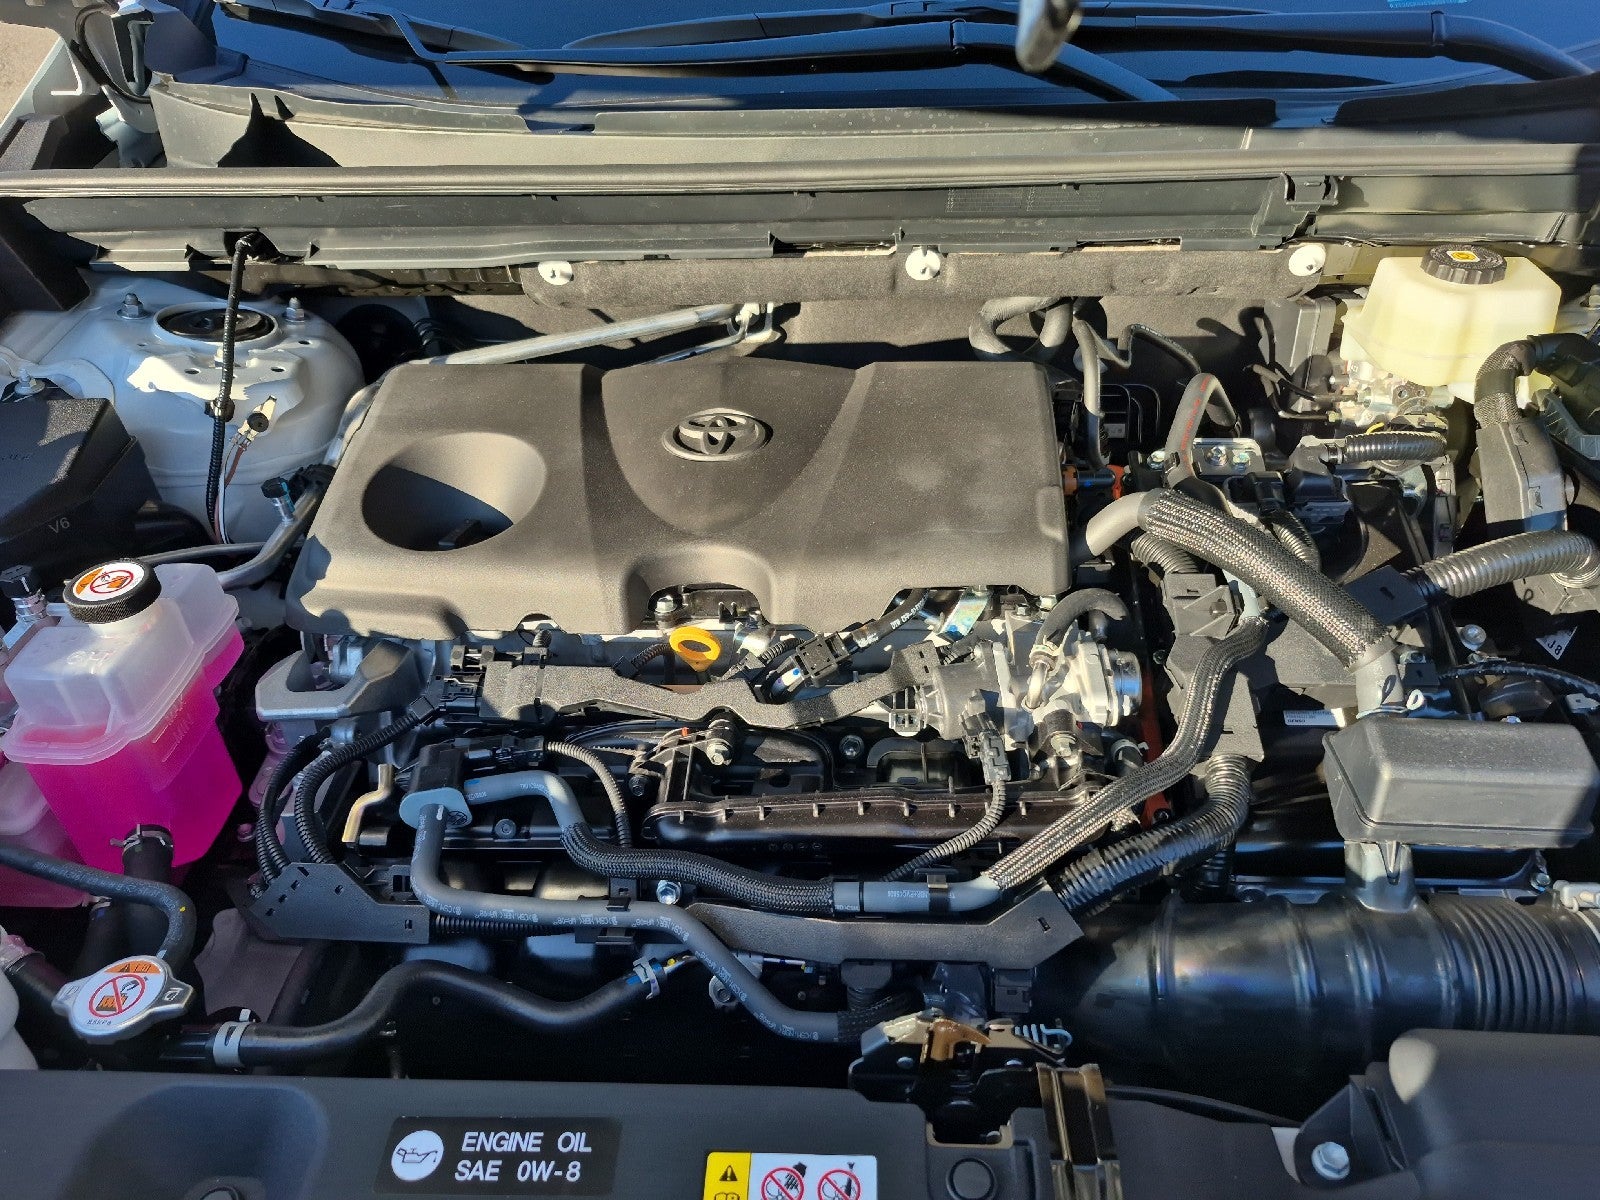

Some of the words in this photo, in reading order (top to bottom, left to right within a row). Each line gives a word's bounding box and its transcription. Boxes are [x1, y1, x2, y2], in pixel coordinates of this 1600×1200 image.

[48, 517, 70, 533] V6
[461, 1131, 544, 1152] ENGINE
[557, 1131, 592, 1153] OIL
[454, 1160, 503, 1181] SAE
[517, 1160, 581, 1182] 0W-8
